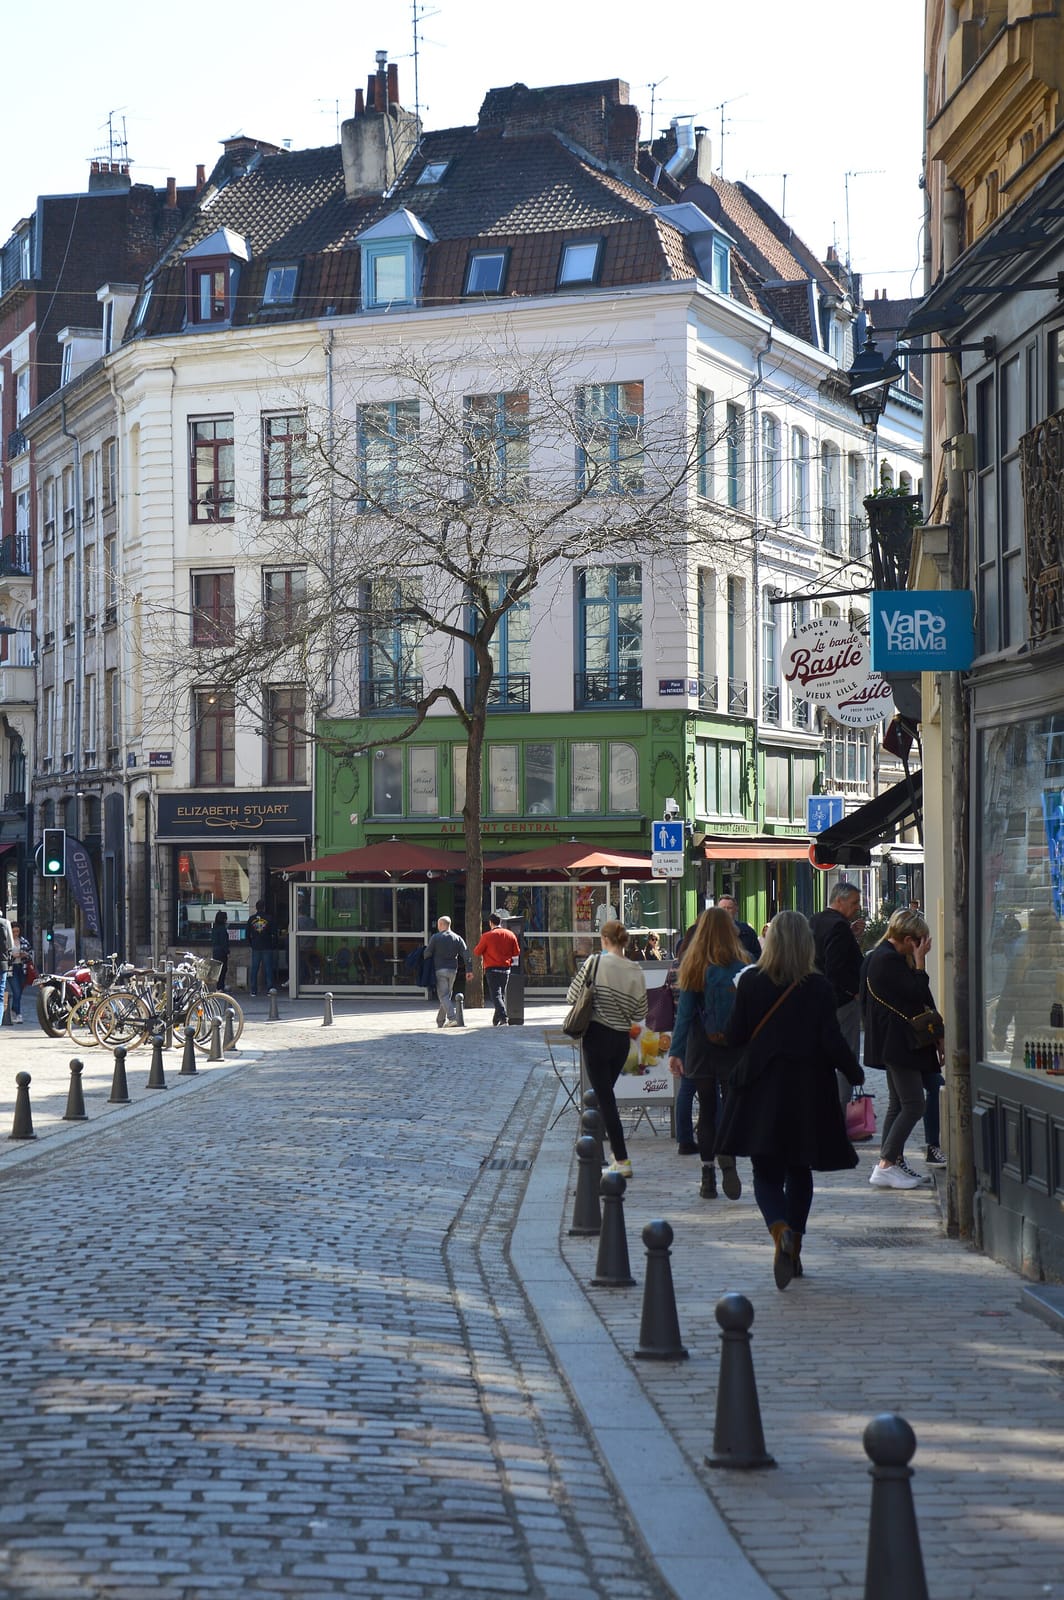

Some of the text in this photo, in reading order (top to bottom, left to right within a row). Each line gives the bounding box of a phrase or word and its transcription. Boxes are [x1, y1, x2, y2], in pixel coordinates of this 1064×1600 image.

[799, 620, 823, 634] MADE
[812, 633, 859, 653] La bande
[887, 632, 947, 651] RaMa
[785, 645, 864, 687] Basile
[805, 681, 858, 700] VIEUX LILLE
[840, 711, 885, 723] VIEUX LILLE
[177, 804, 289, 816] ELIZABETH STUART
[441, 824, 456, 833] AU
[503, 823, 559, 832] CENTRAL
